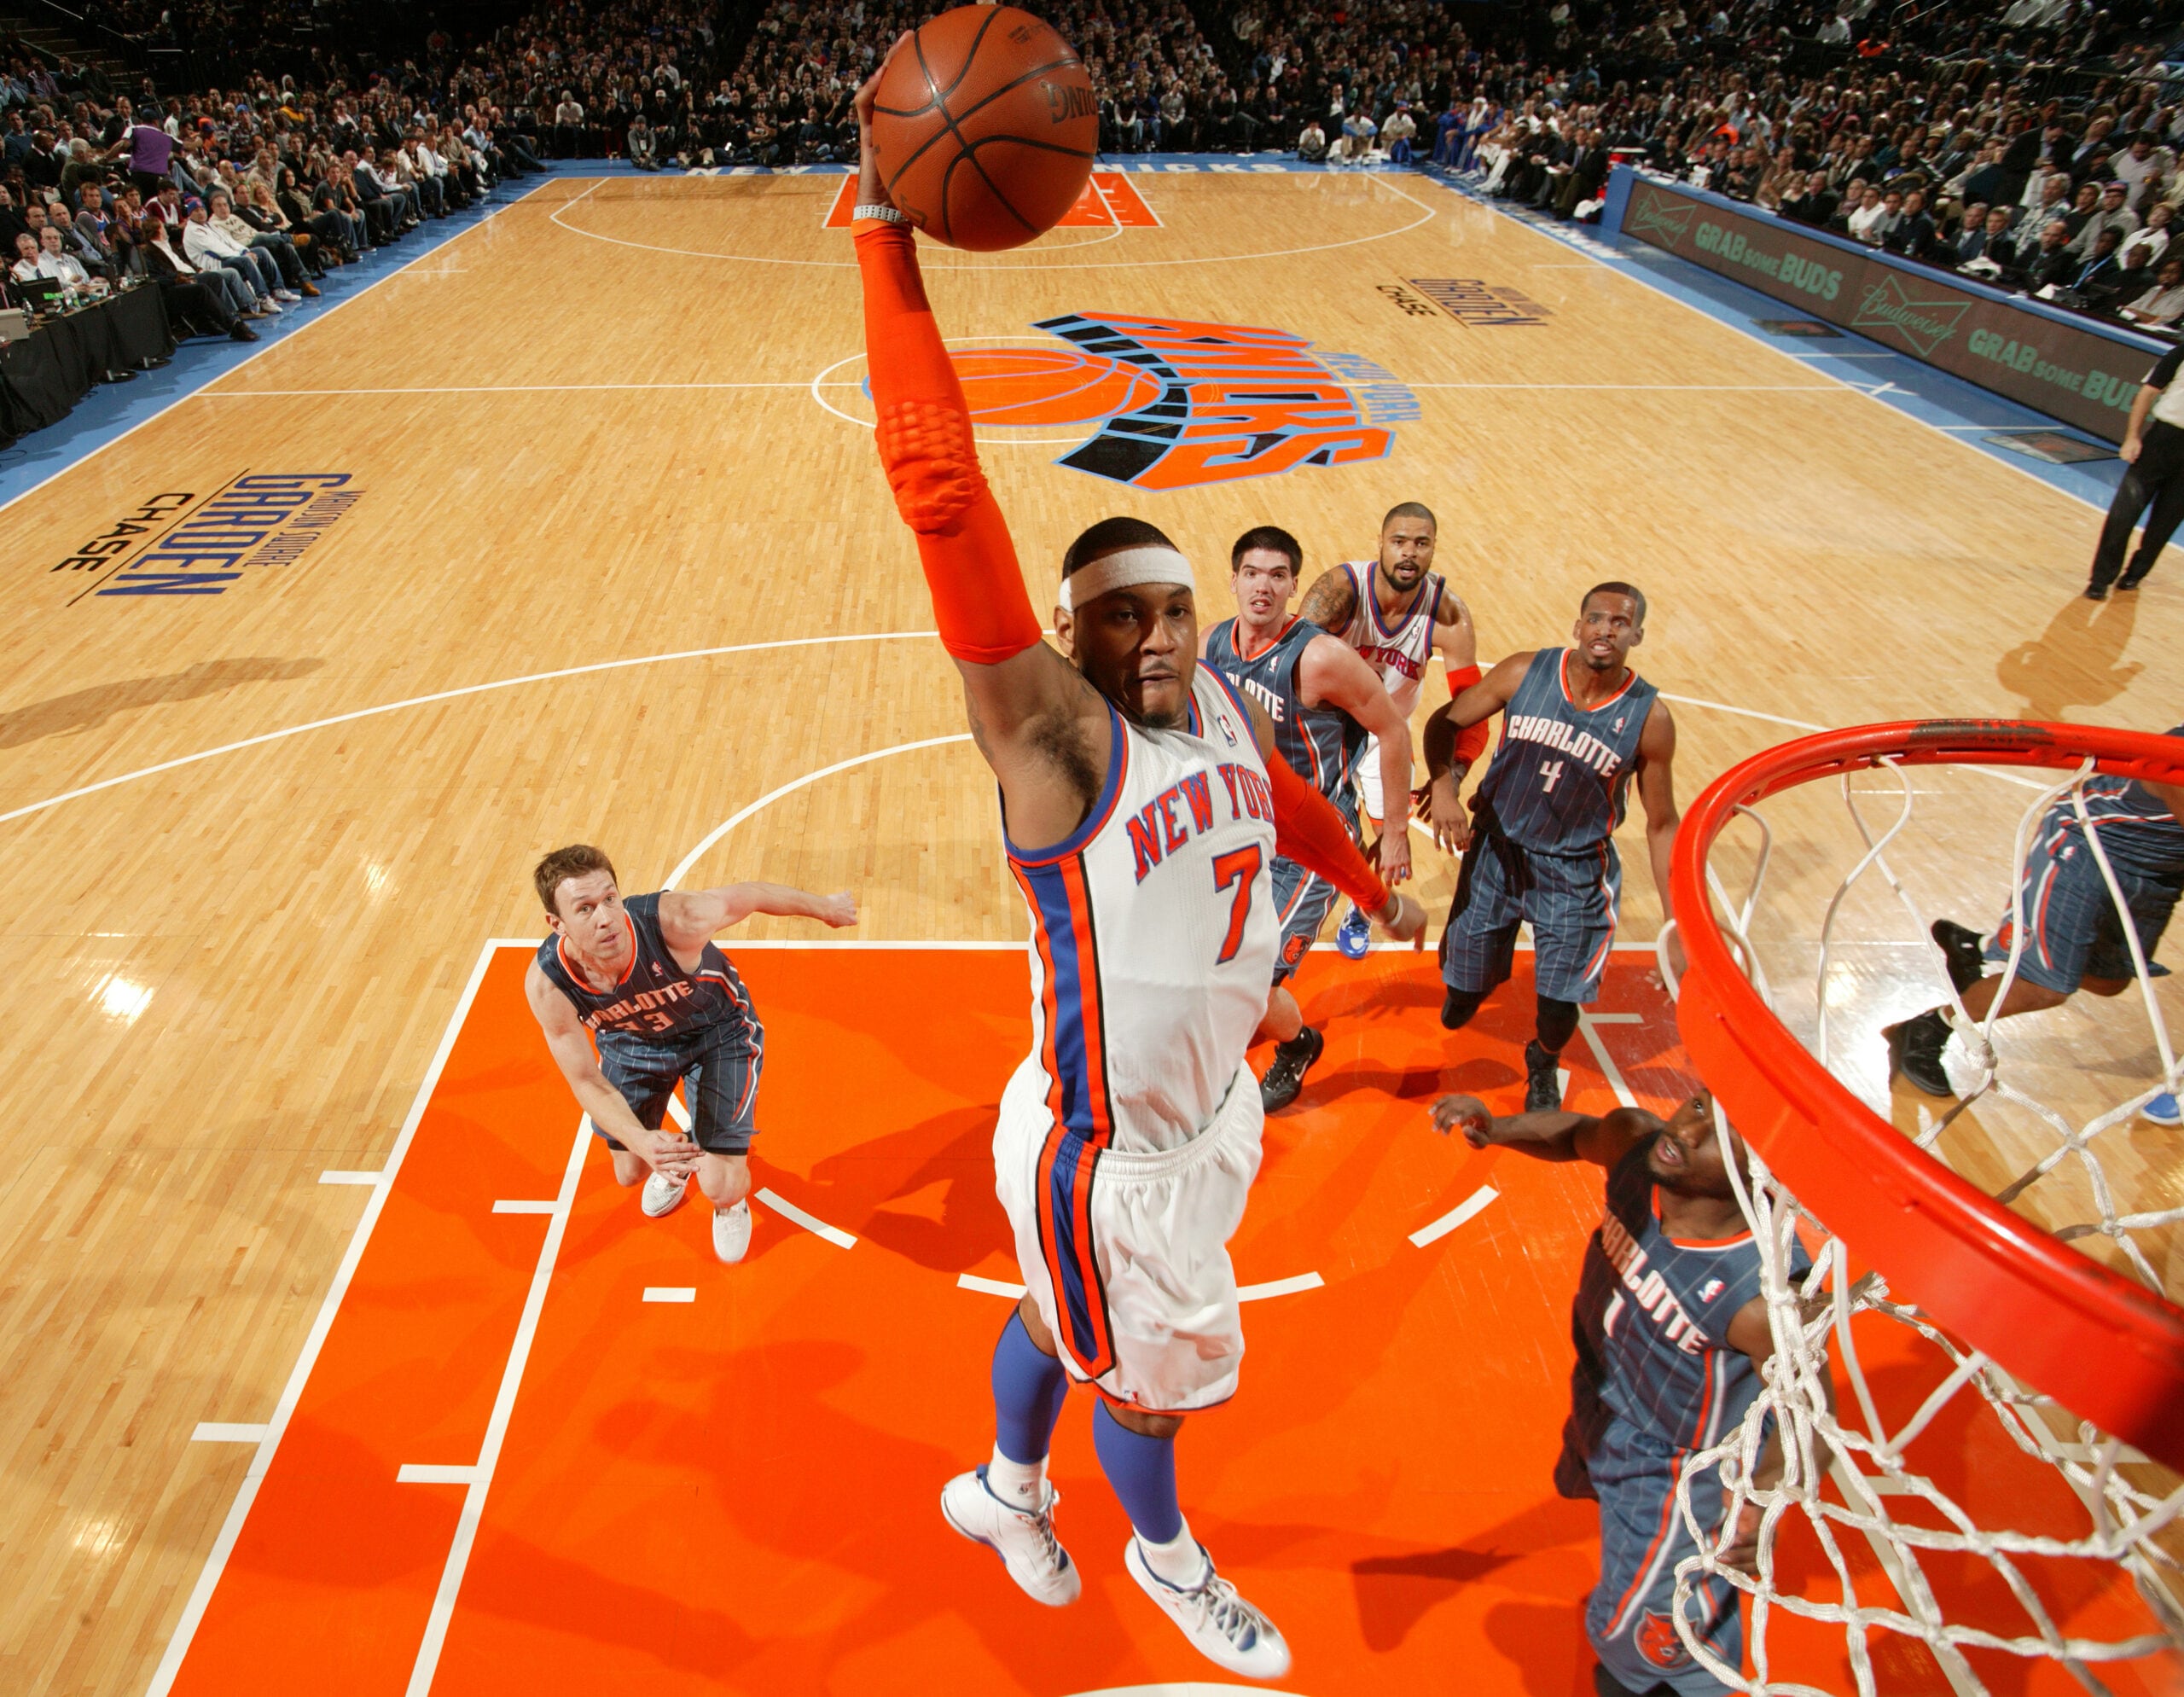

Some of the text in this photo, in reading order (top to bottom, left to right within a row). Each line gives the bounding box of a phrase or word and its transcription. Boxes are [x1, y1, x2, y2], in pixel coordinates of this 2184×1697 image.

[1047, 84, 1097, 125] DING
[685, 166, 812, 177] NEW
[1092, 163, 1287, 172] NICKS
[1694, 222, 1843, 300] GRAB SOME BUDS
[1375, 285, 1438, 317] CHASE
[1863, 284, 1955, 340] Budweiser
[1968, 328, 2156, 421] GRAB SOME BUD
[49, 492, 195, 573] CHASE
[95, 474, 353, 596] GARDEN
[242, 490, 367, 568] MADISON SQUARE
[1375, 646, 1420, 681] YORK
[1507, 714, 1622, 778] CHARLOTTE
[1539, 760, 1565, 793] 4
[1125, 770, 1214, 886] NEW
[1211, 841, 1263, 966] 7
[580, 980, 694, 1030] HARLOTTE
[1601, 1206, 1710, 1356] HARLOTTE
[1603, 1287, 1625, 1339] 1
